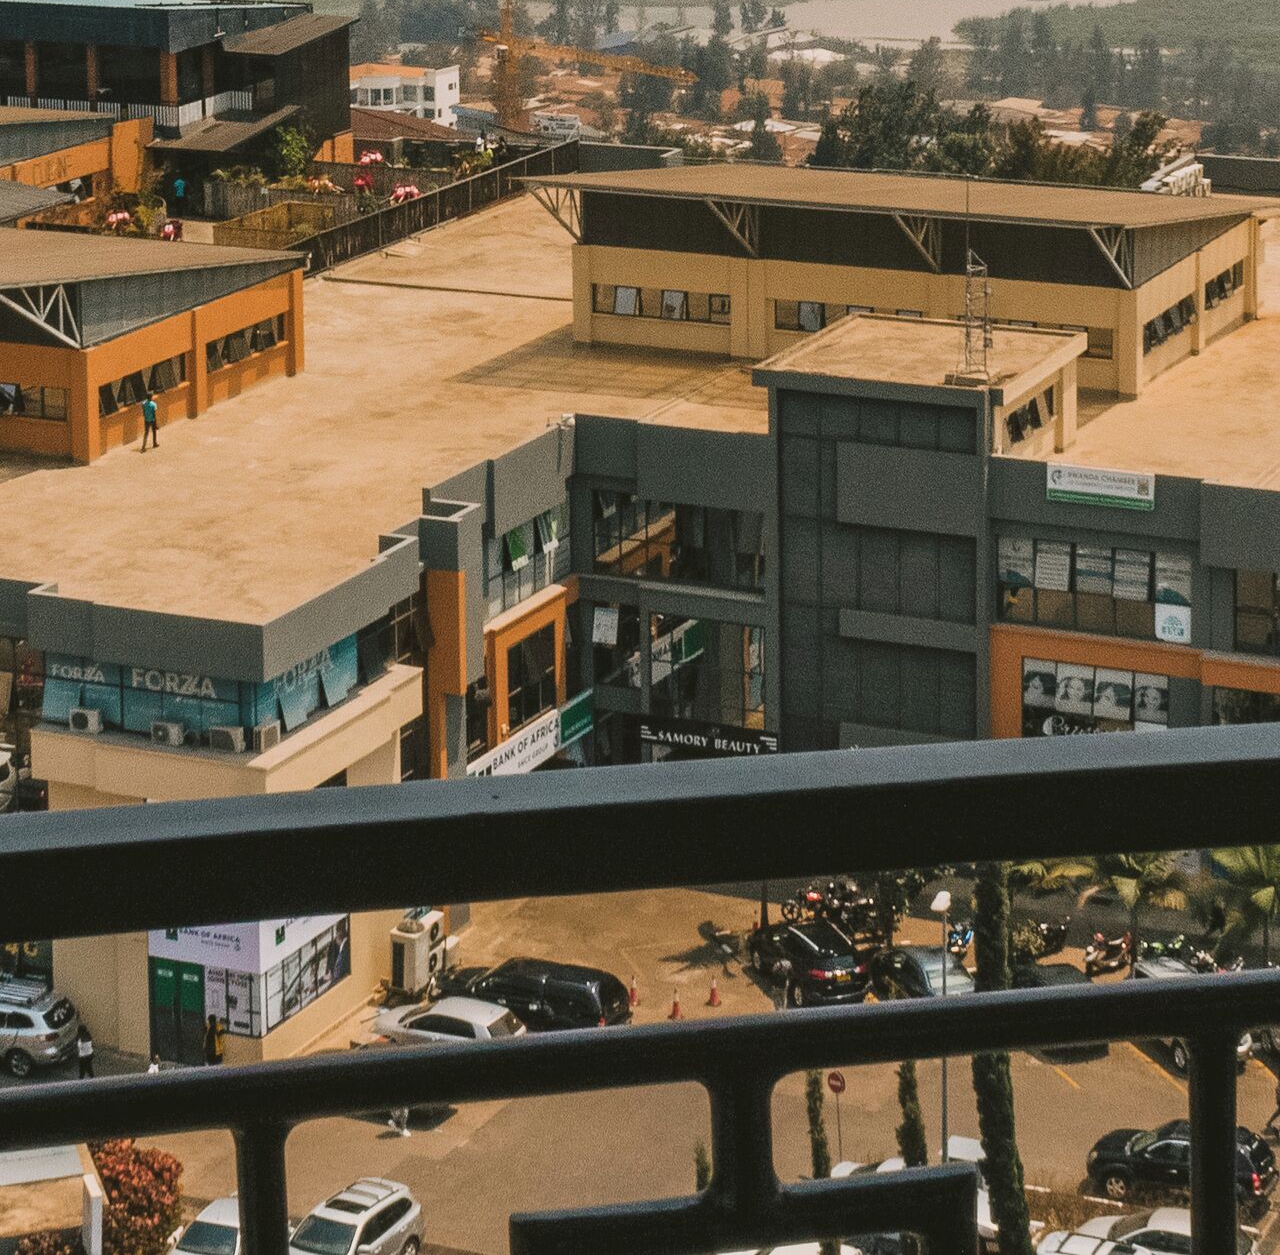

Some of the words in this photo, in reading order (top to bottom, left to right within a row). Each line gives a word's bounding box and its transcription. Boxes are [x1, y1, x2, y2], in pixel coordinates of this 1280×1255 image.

[493, 746, 515, 770] BANK
[517, 738, 528, 754] OF
[530, 718, 560, 744] AFRICA
[658, 730, 708, 747] SAMORY
[714, 738, 760, 754] BEAUTY
